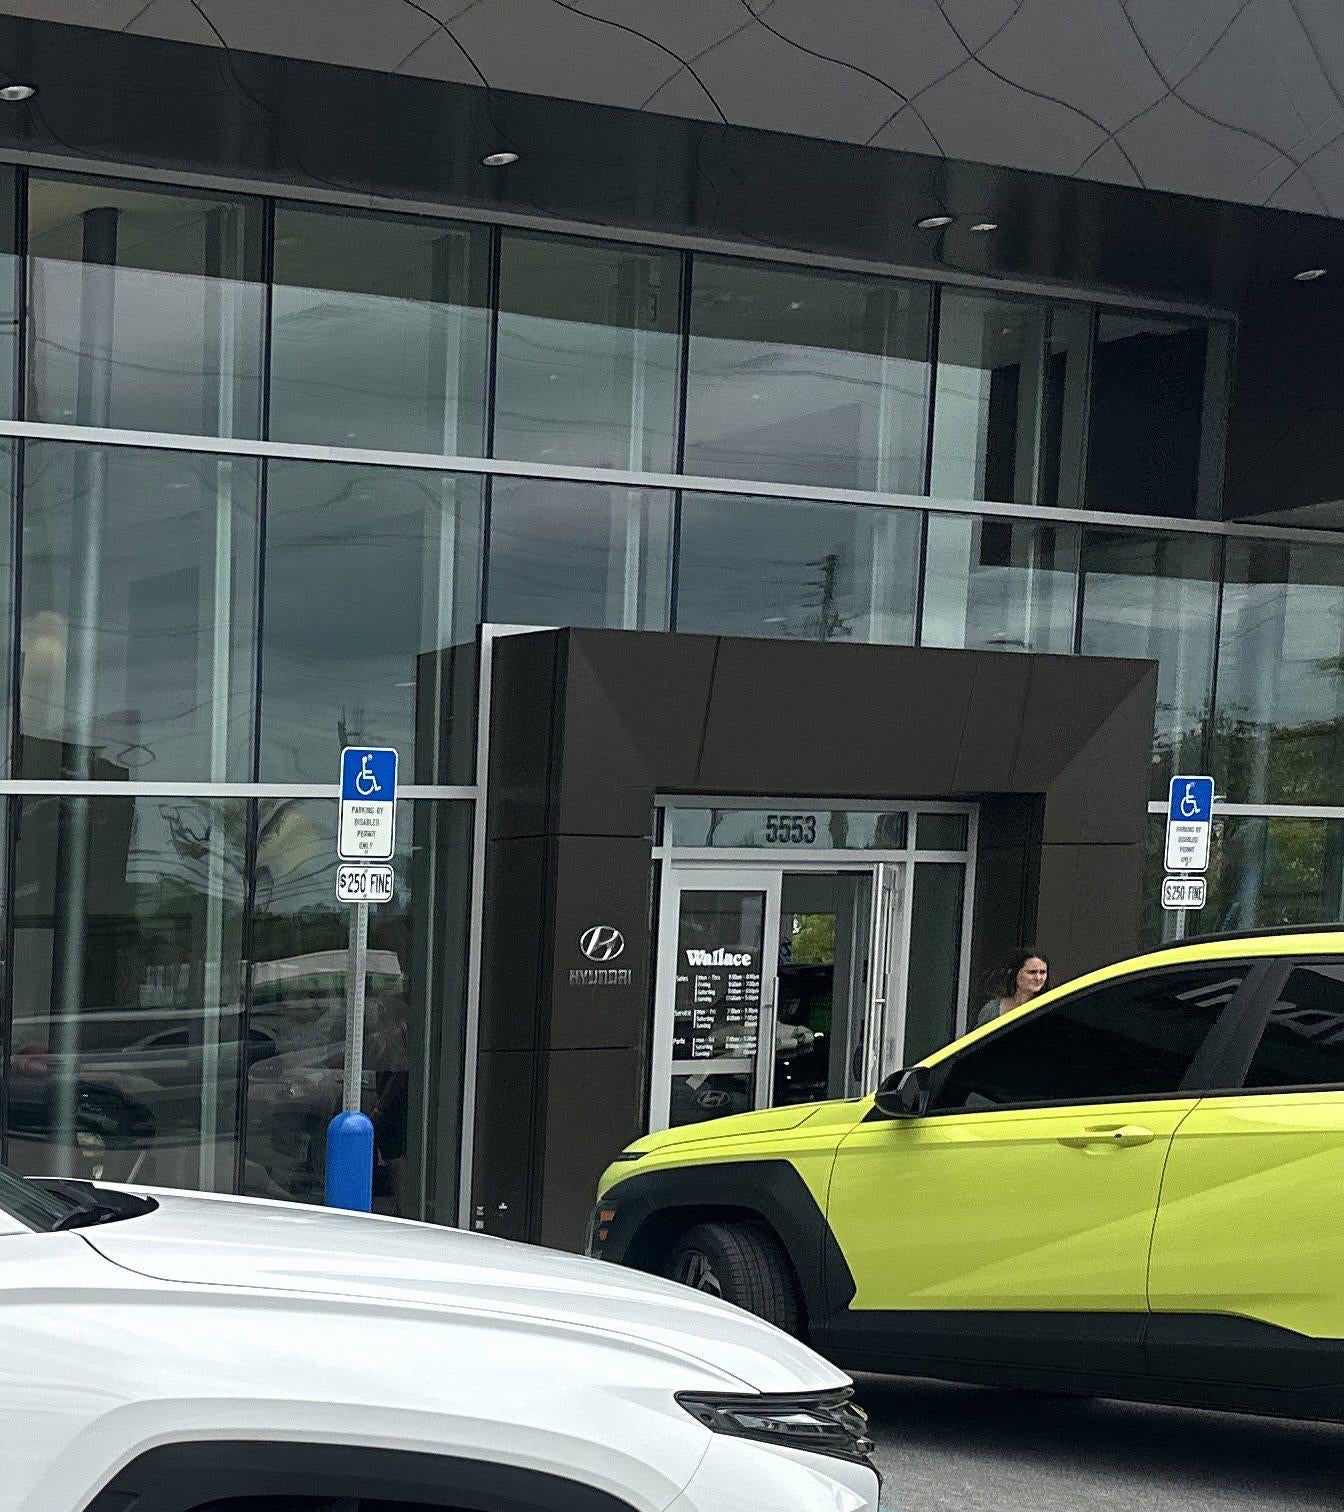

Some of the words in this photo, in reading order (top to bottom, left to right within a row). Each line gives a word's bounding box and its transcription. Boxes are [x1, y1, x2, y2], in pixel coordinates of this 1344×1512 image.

[765, 815, 817, 843] 5553
[339, 872, 366, 894] $250
[370, 873, 391, 894] FINE
[1165, 885, 1185, 901] $250
[685, 948, 752, 966] Wallace
[569, 969, 632, 985] HYUNDAI
